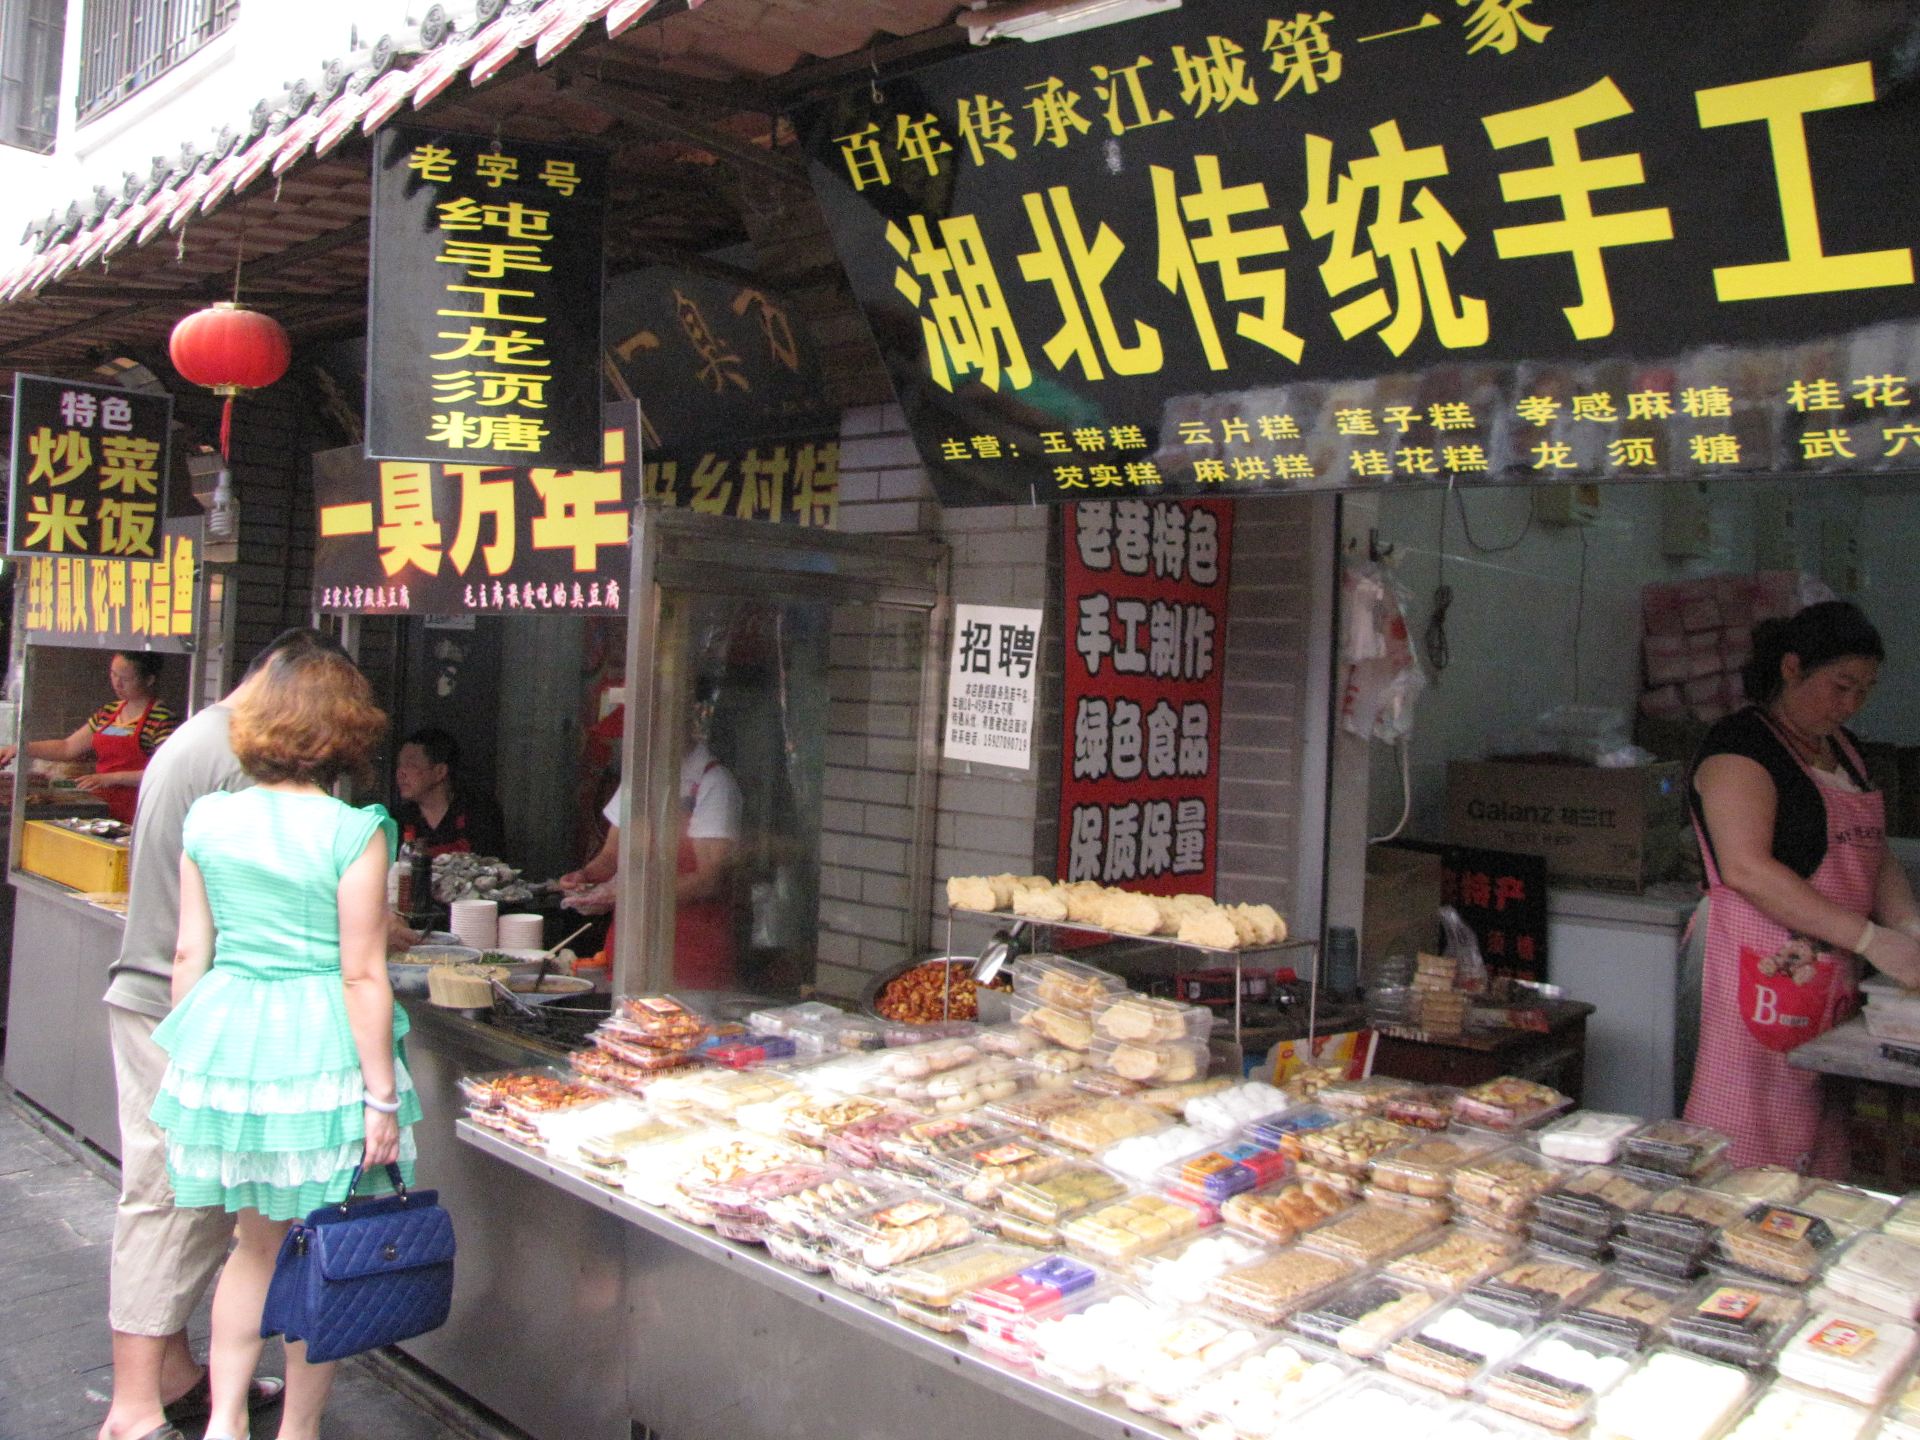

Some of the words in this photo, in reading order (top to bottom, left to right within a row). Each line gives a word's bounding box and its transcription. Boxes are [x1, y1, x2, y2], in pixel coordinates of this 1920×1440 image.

[832, 0, 1554, 192] 百年传承江城第一家
[407, 144, 581, 197] 老字号
[885, 61, 1915, 393] 湖北传统手工
[425, 197, 554, 453] 纯手工龙须糖
[61, 391, 133, 432] 特色
[1040, 425, 1148, 455] 玉带糕
[1178, 413, 1300, 446] 云片糕
[1335, 402, 1477, 436] 莲子糕
[1516, 386, 1734, 428] 孝感麻糖
[1786, 373, 1911, 413] 桂花
[27, 426, 161, 494] 炒菜
[1053, 460, 1164, 490] 芡实糕
[1193, 453, 1315, 484] 麻烘糕
[1350, 443, 1489, 476] 桂花糕
[1530, 435, 1742, 470] 龙须糖
[25, 494, 157, 556] 米饭
[960, 619, 1036, 679] 招聘
[1077, 594, 1216, 680] 手工制作
[1073, 697, 1210, 781] 绿色食品
[1069, 799, 1207, 882] 保质保量
[1467, 799, 1554, 824] Galanz
